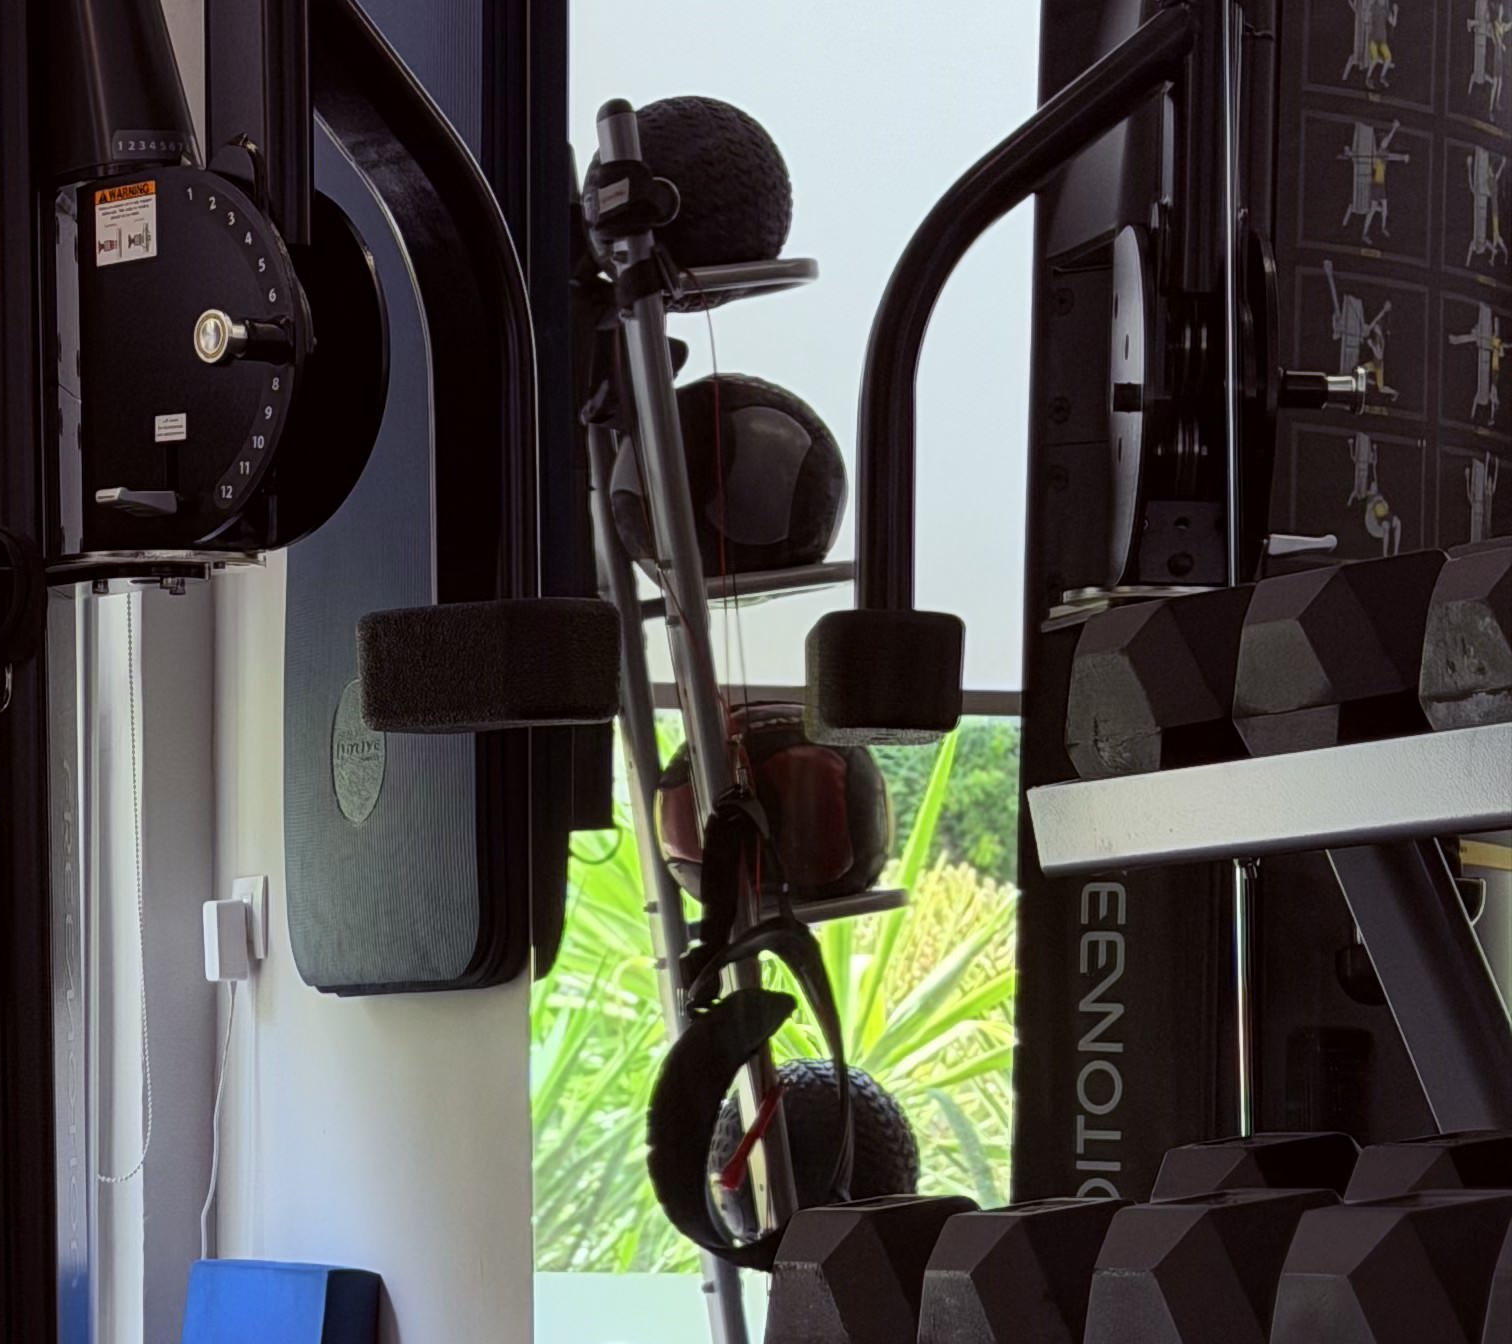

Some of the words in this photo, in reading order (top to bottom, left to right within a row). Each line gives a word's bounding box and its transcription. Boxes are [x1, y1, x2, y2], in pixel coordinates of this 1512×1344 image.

[118, 141, 123, 151] 1
[128, 141, 136, 150] 2
[138, 141, 146, 150] 3
[109, 183, 149, 200] WARNING
[186, 188, 192, 200] 1
[208, 196, 216, 210] 2
[228, 212, 236, 226] 3
[244, 232, 252, 244] 4
[258, 258, 266, 272] 5
[268, 288, 276, 302] 6
[272, 376, 280, 390] 8
[264, 406, 272, 420] 9
[252, 436, 264, 448] 10
[240, 460, 250, 474] 11
[220, 486, 232, 498] 12
